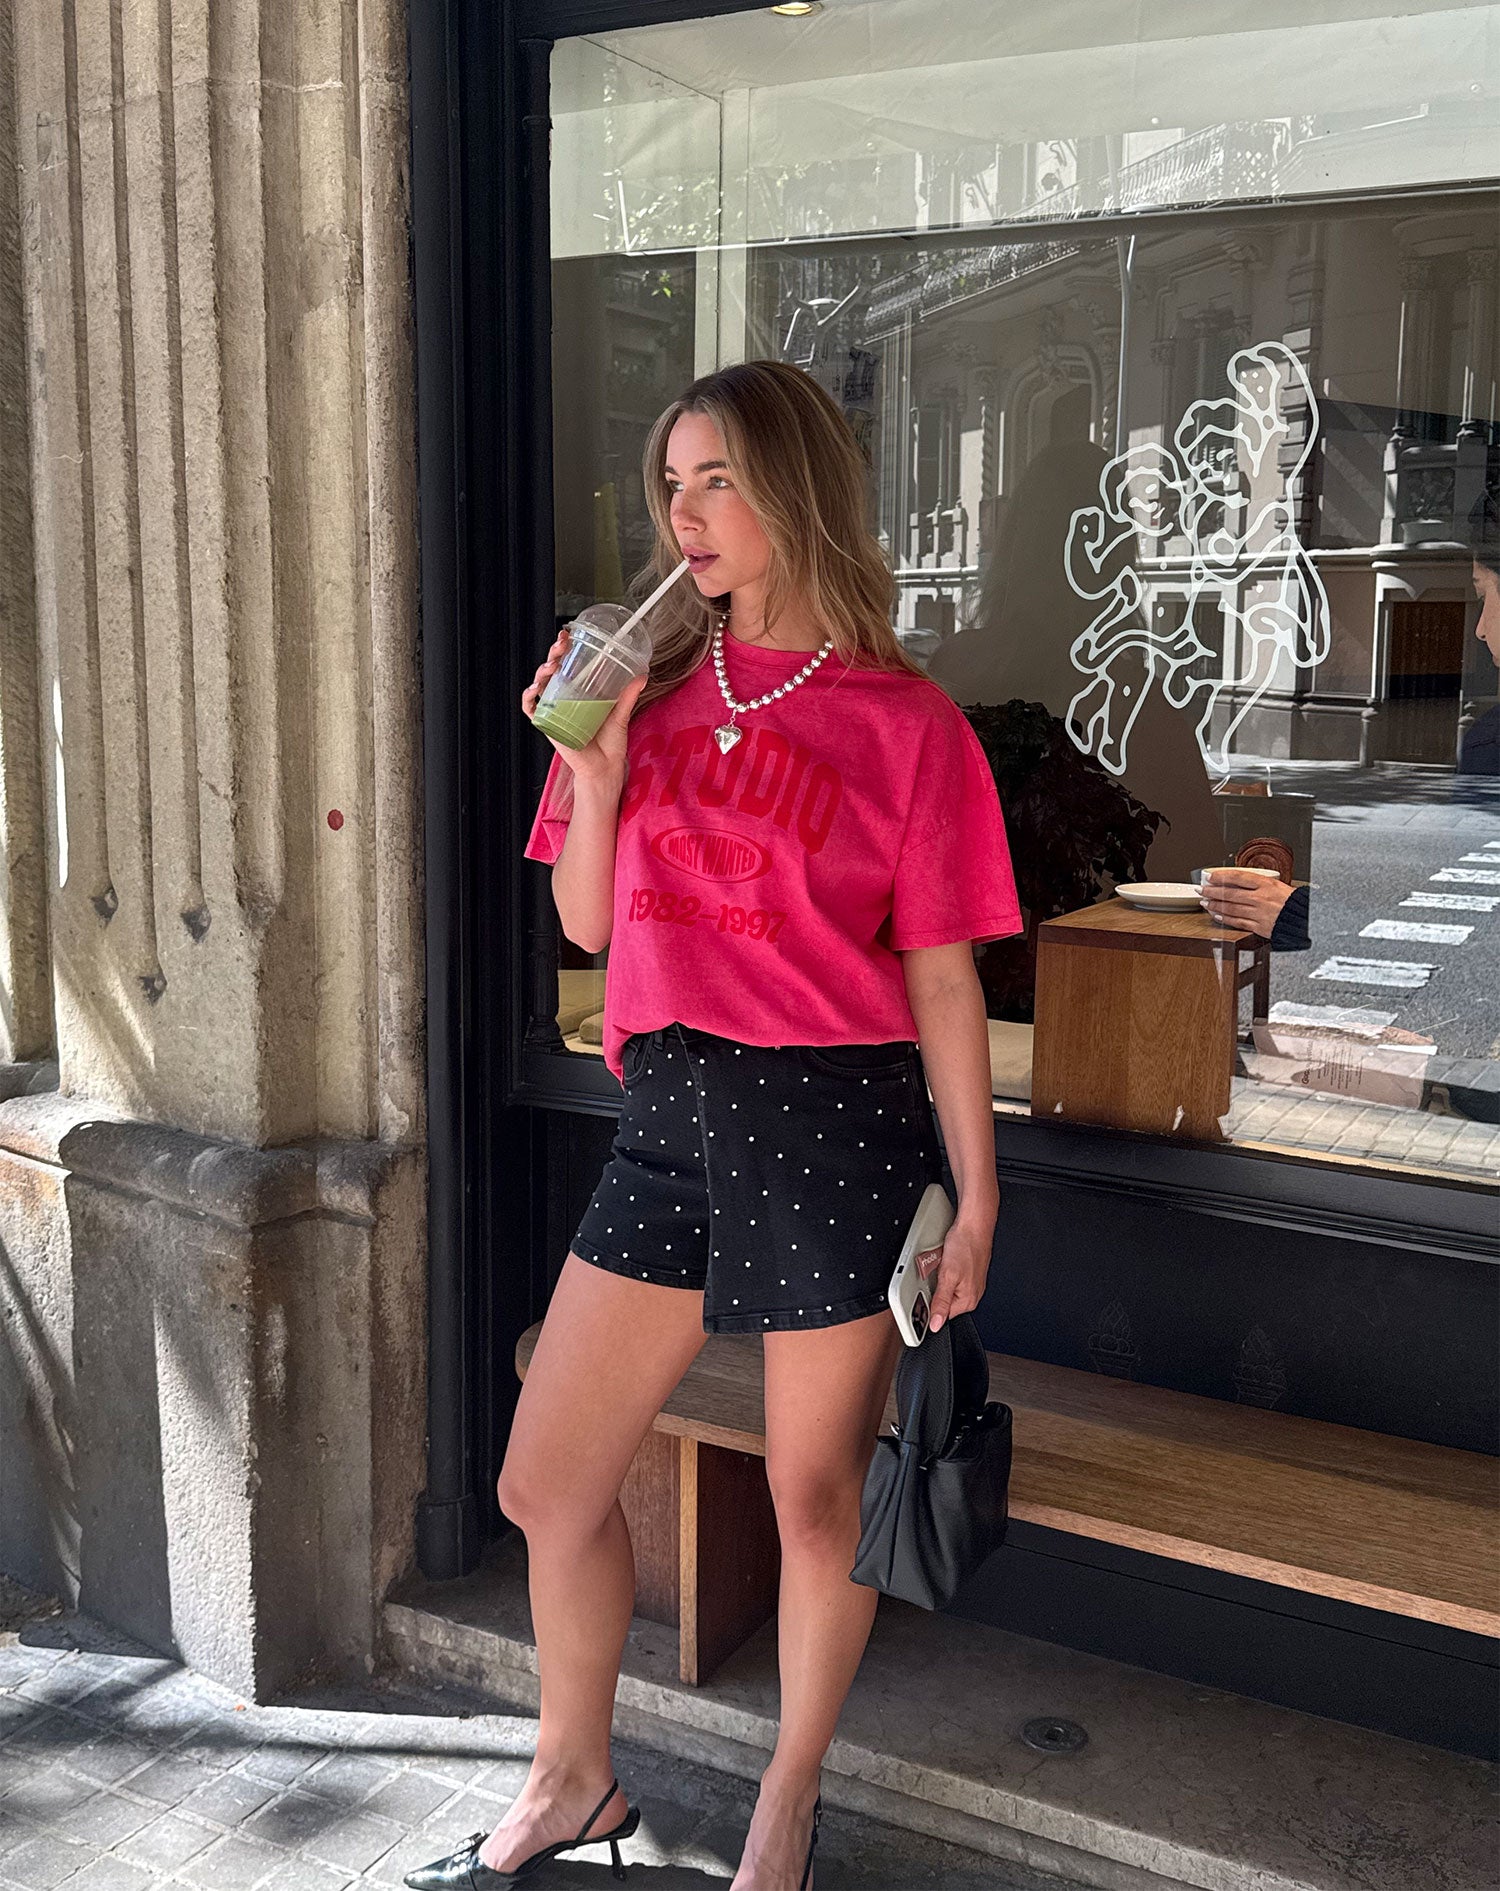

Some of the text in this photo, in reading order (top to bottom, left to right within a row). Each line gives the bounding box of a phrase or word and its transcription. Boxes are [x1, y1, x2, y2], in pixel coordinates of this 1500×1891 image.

[622, 725, 843, 856] STUDIO
[668, 833, 756, 875] MOST WANTED
